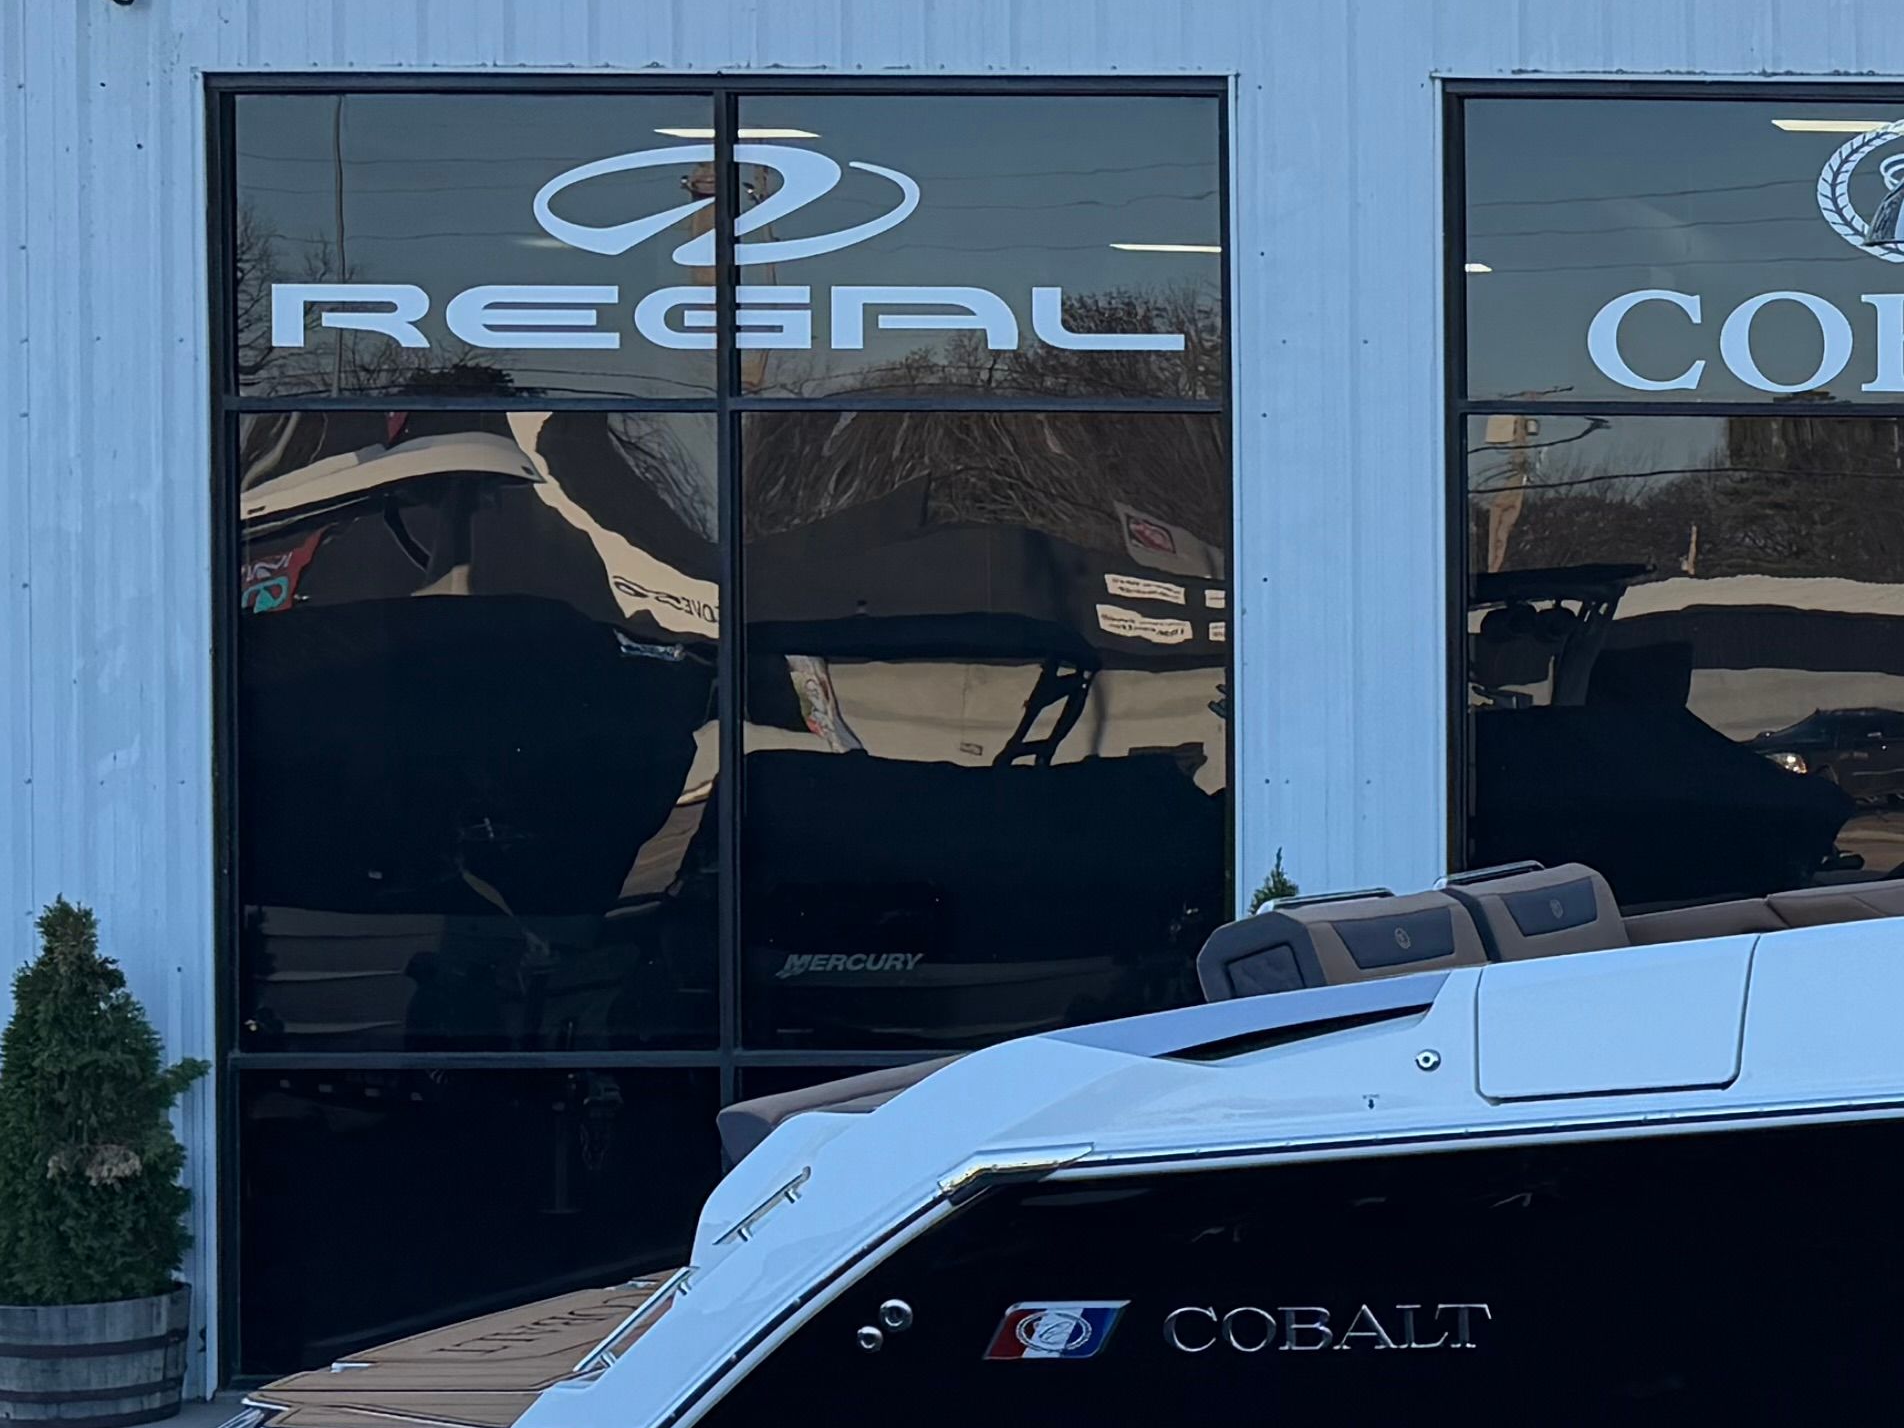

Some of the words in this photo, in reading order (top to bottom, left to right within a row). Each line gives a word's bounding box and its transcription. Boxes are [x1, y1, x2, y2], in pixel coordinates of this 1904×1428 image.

[271, 283, 1185, 351] REGAL
[776, 952, 925, 980] MERCURY
[1162, 1302, 1494, 1353] COBALT
